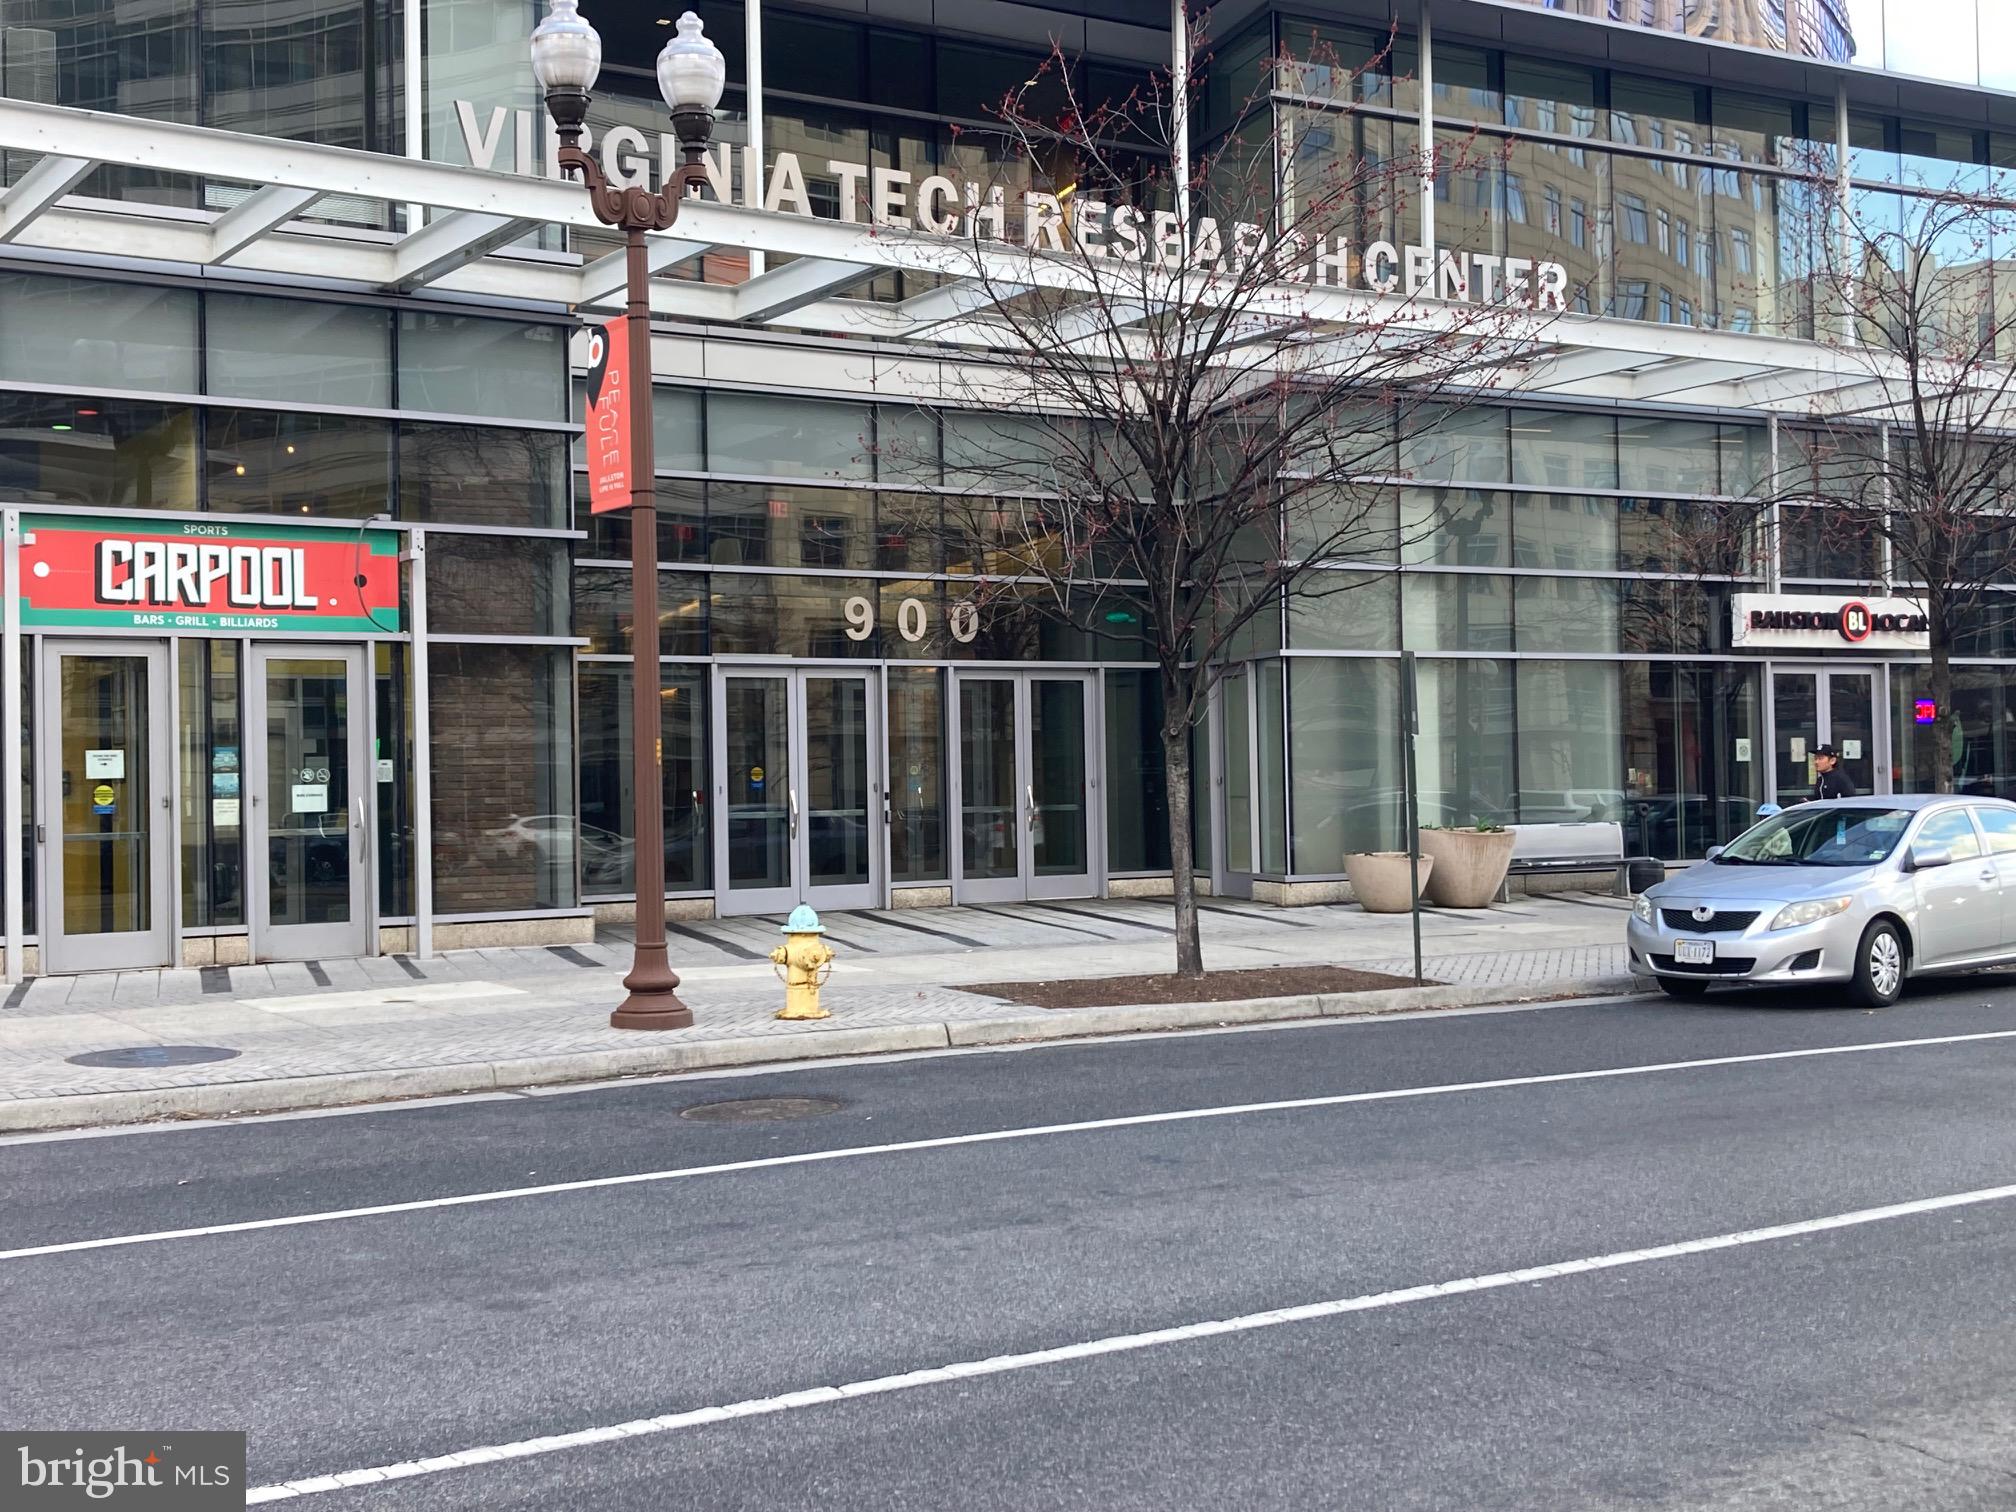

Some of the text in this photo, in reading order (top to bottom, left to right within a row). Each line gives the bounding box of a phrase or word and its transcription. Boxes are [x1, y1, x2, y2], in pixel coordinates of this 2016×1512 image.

[827, 160, 1005, 243] TECH
[1024, 191, 1349, 289] RESEARCH
[1362, 240, 1568, 312] CENTER
[183, 524, 228, 536] SPORTS
[98, 539, 318, 609] CARPOOL
[133, 614, 279, 629] BARS GRILL BILLIARDS
[844, 596, 979, 643] 900
[1848, 611, 1867, 631] BL
